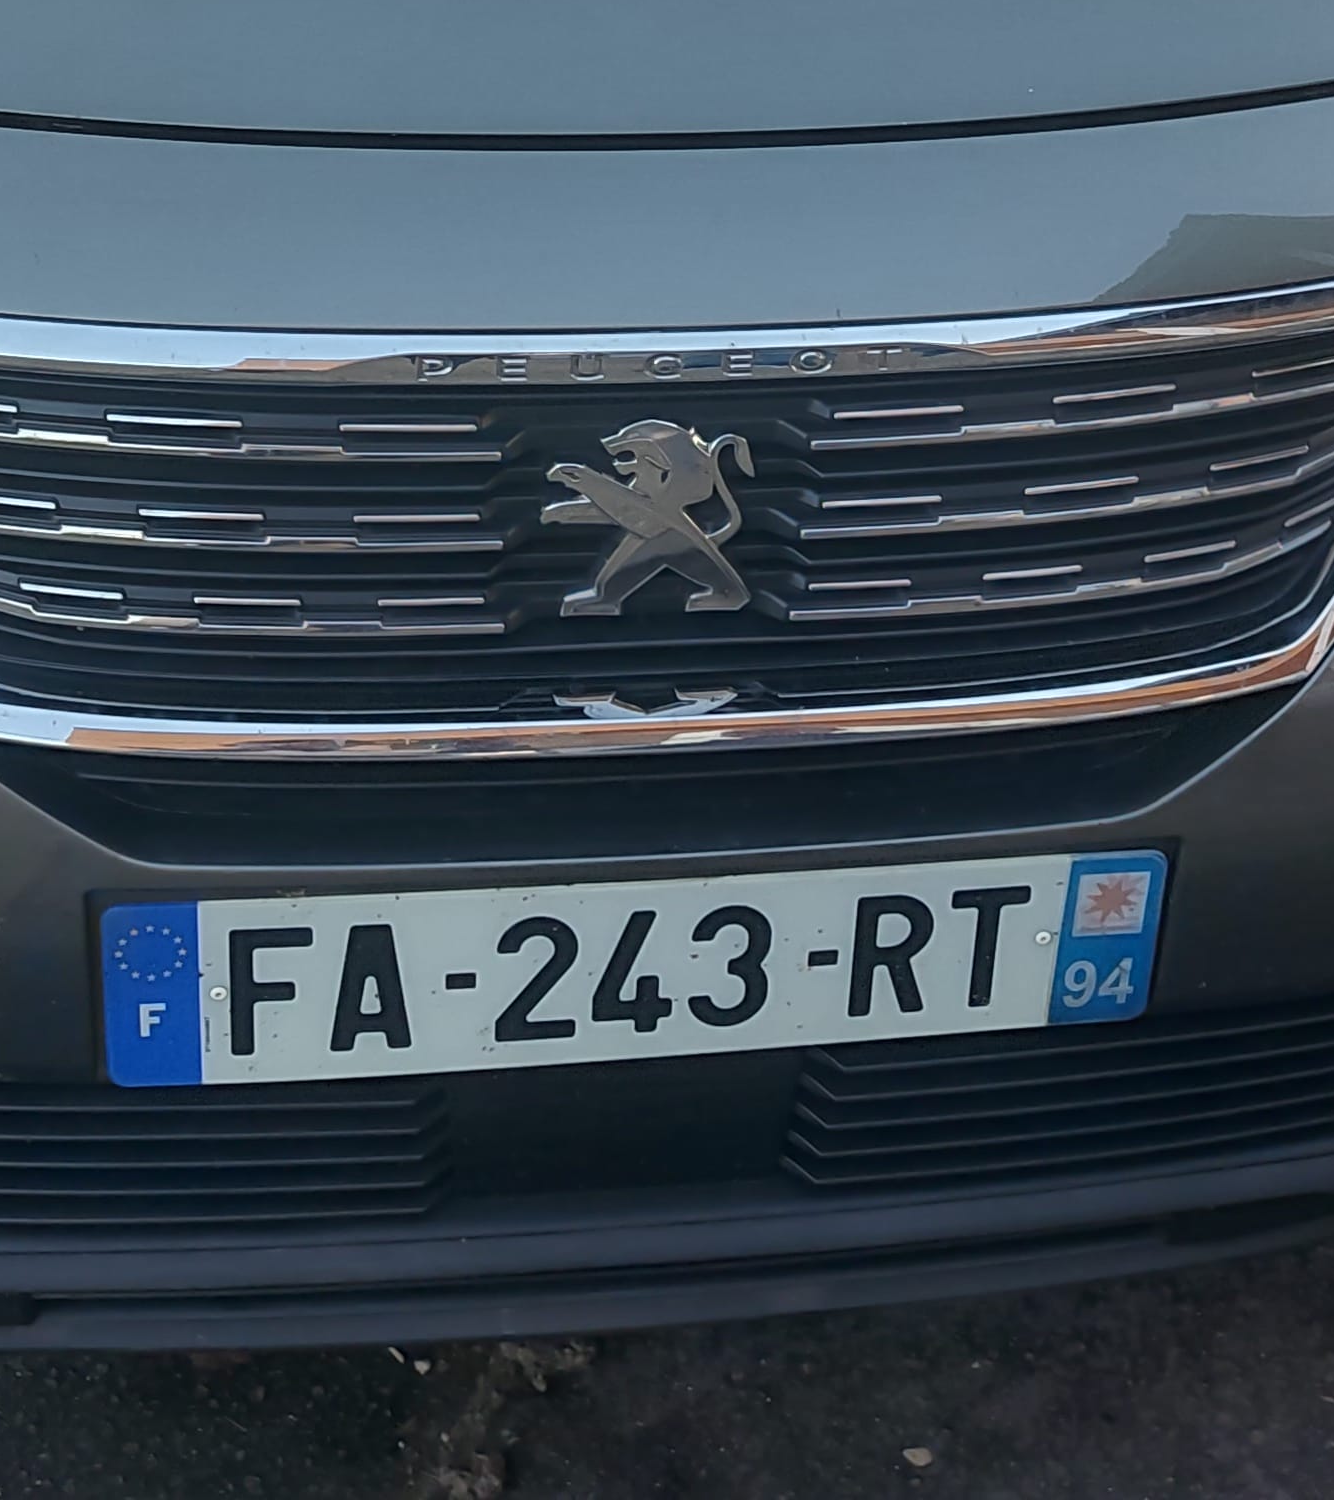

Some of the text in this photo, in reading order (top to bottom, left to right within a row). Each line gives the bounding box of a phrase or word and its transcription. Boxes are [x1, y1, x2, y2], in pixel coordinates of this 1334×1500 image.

[415, 346, 903, 383] PEUGEOT
[229, 885, 1032, 1056] FA-243-RT
[1062, 957, 1135, 1008] 94
[138, 1002, 167, 1038] F
